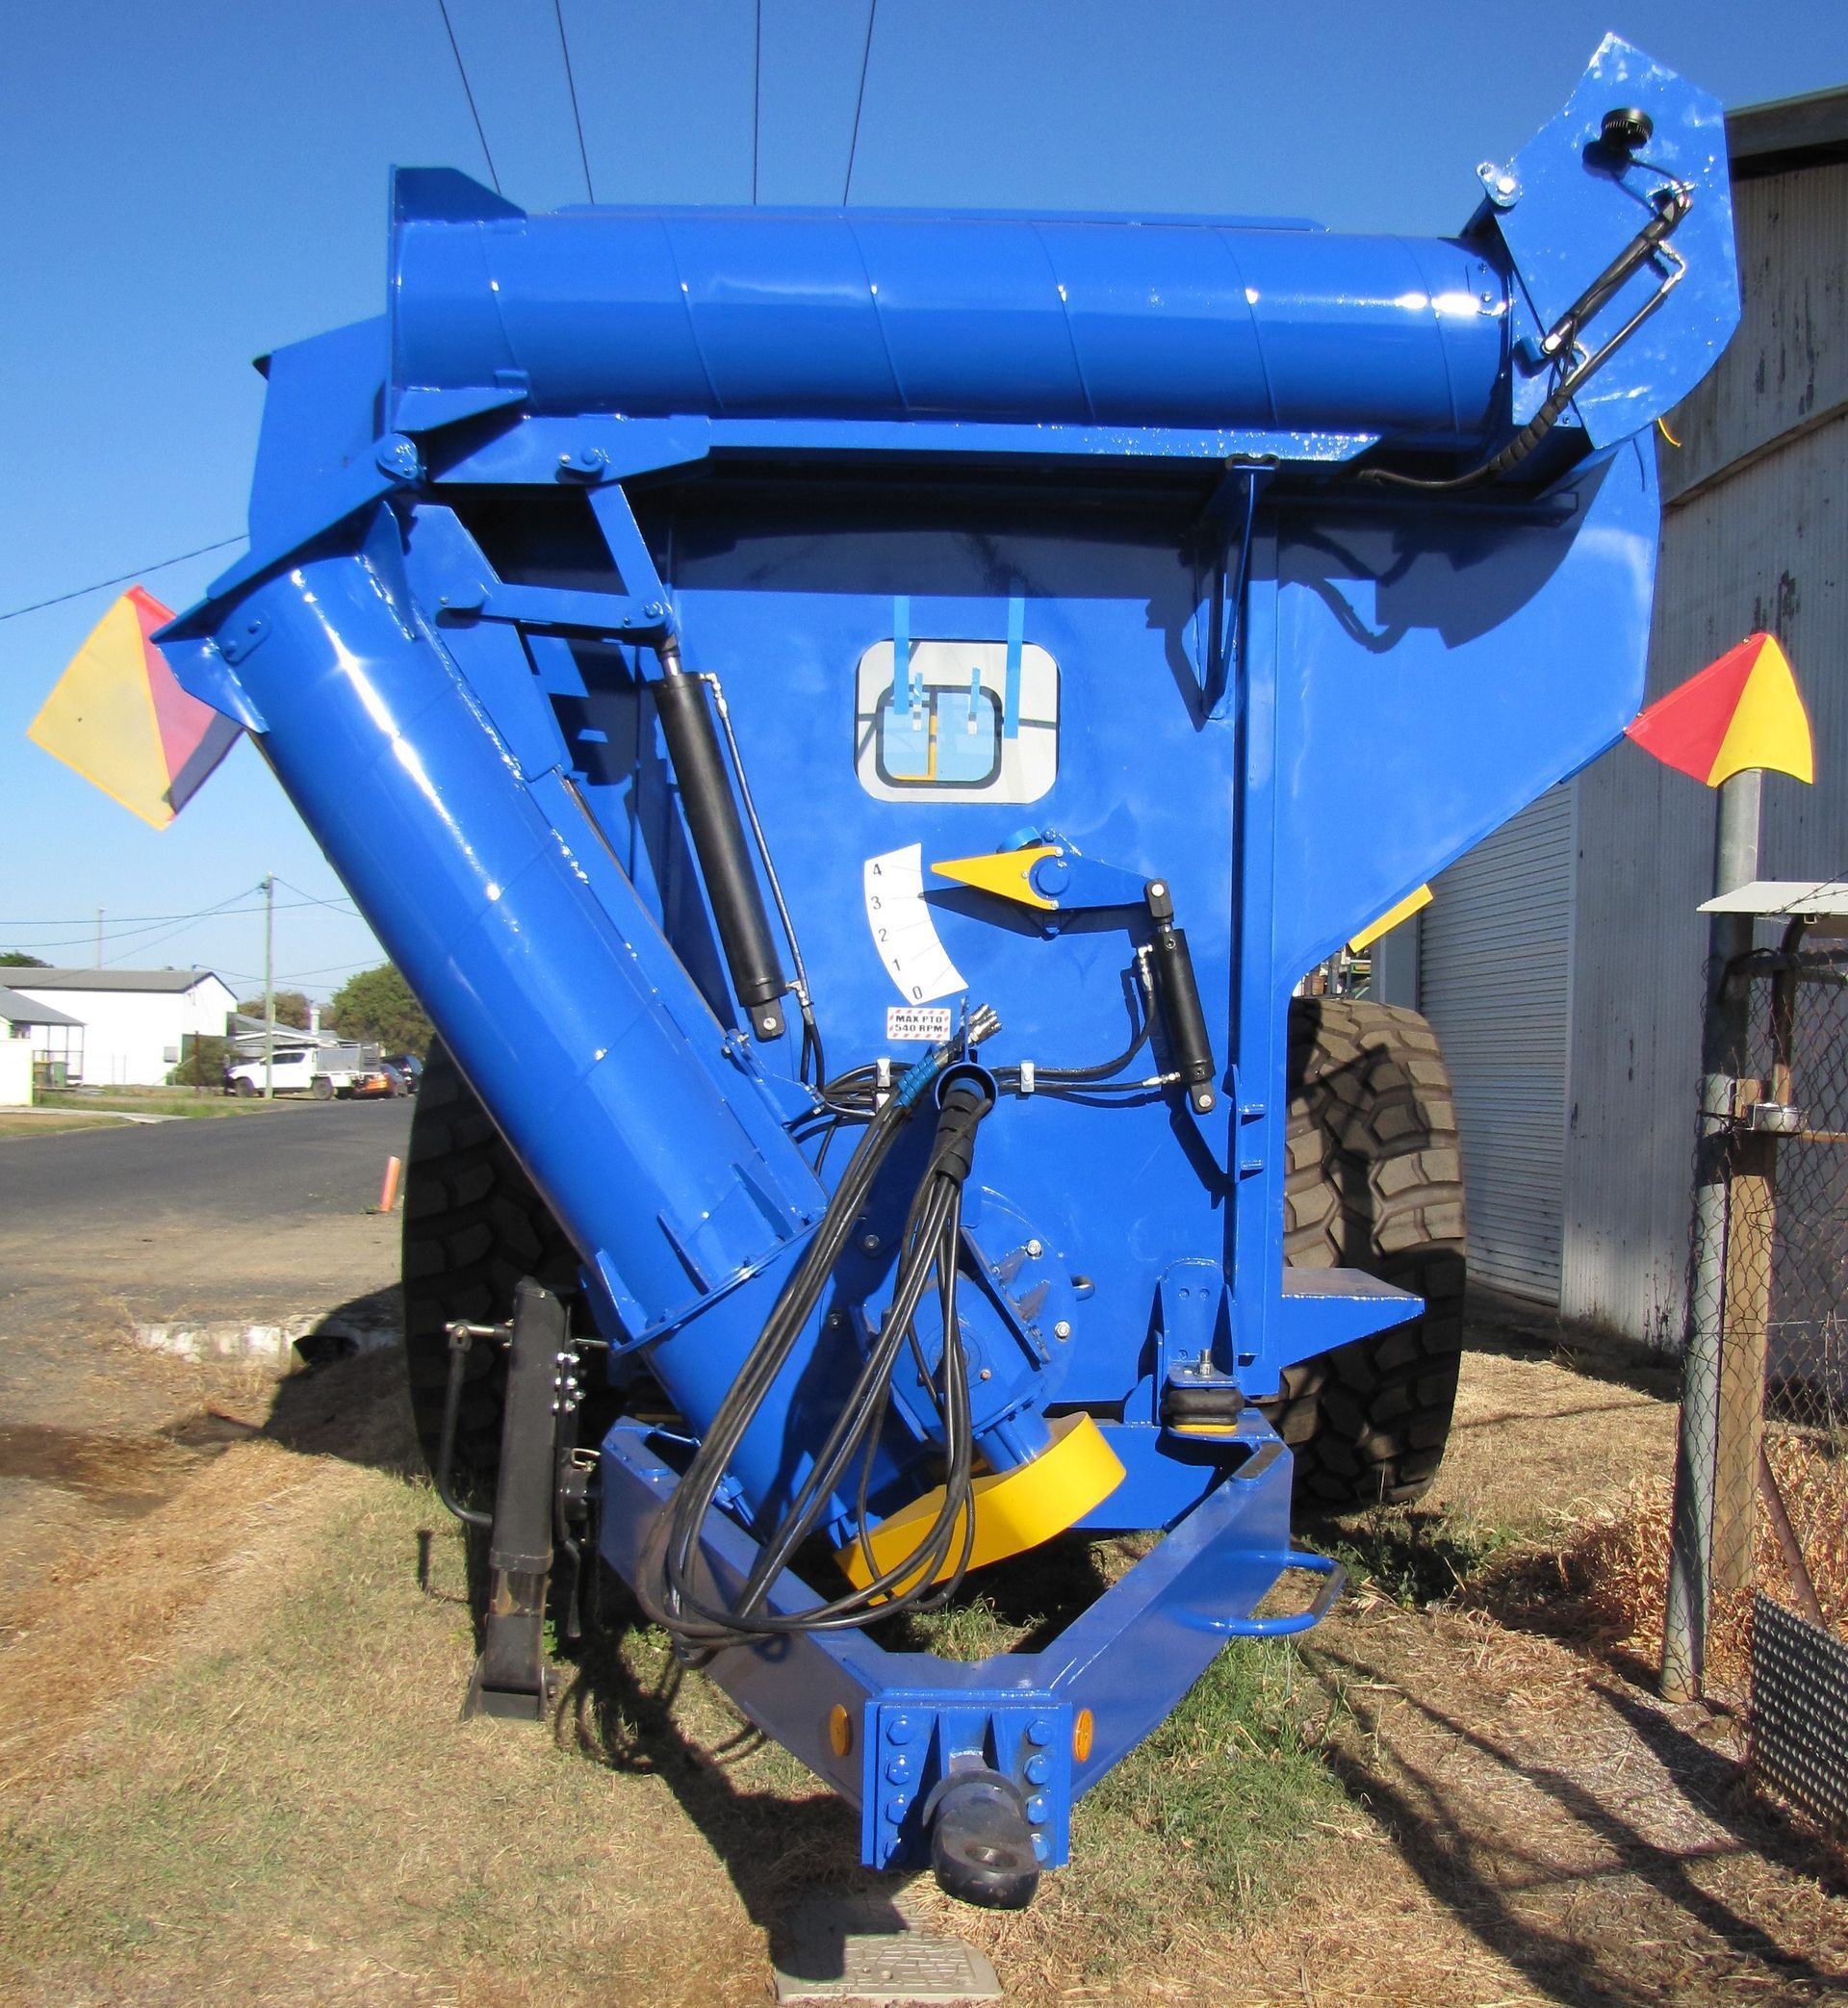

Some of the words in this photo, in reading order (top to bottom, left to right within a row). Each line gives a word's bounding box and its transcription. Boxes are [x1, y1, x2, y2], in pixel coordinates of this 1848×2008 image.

[873, 862, 882, 876] 4
[871, 896, 882, 910] 3
[878, 928, 888, 942] 2
[892, 959, 901, 971] 1
[911, 986, 923, 1000] 0
